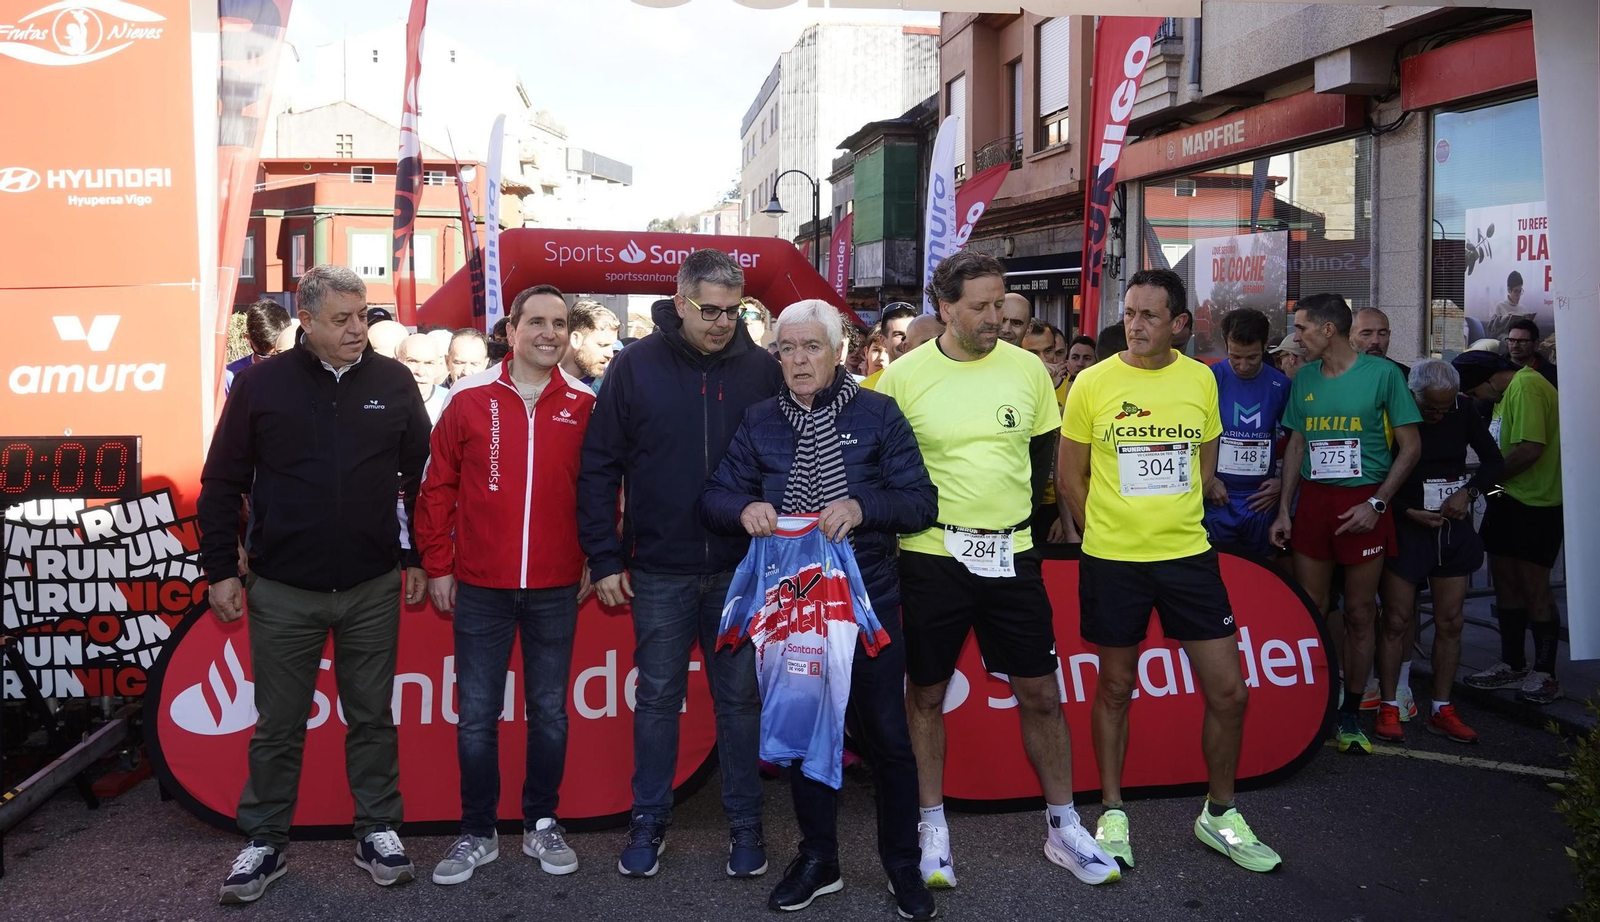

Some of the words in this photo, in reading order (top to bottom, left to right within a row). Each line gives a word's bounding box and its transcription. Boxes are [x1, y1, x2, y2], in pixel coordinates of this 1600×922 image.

[0, 23, 49, 40] Frutas
[107, 22, 163, 40] Nieves
[1182, 119, 1245, 157] MAPFRE
[47, 168, 172, 189] HYUNDAI
[68, 195, 123, 207] Hyupersa
[125, 194, 152, 206] Vigo
[1518, 219, 1528, 231] TU
[1529, 217, 1548, 230] REFE
[544, 241, 615, 266] Sports
[1517, 233, 1549, 261] PLA
[836, 239, 846, 298] ntander
[1212, 258, 1226, 283] DE
[1228, 255, 1267, 282] COCHE
[9, 363, 166, 395] amura
[552, 415, 578, 426] Santander
[1305, 416, 1363, 431] BIKILA
[1115, 424, 1202, 439] castrelos
[488, 398, 501, 492] #SportsSantander
[1233, 450, 1257, 463] 148
[1320, 451, 1346, 464] 275
[1138, 458, 1175, 477] 304
[80, 492, 175, 543] RUN
[961, 540, 996, 558] 284
[36, 549, 127, 580] RUN
[4, 635, 83, 667] UN
[788, 643, 823, 655] Santand
